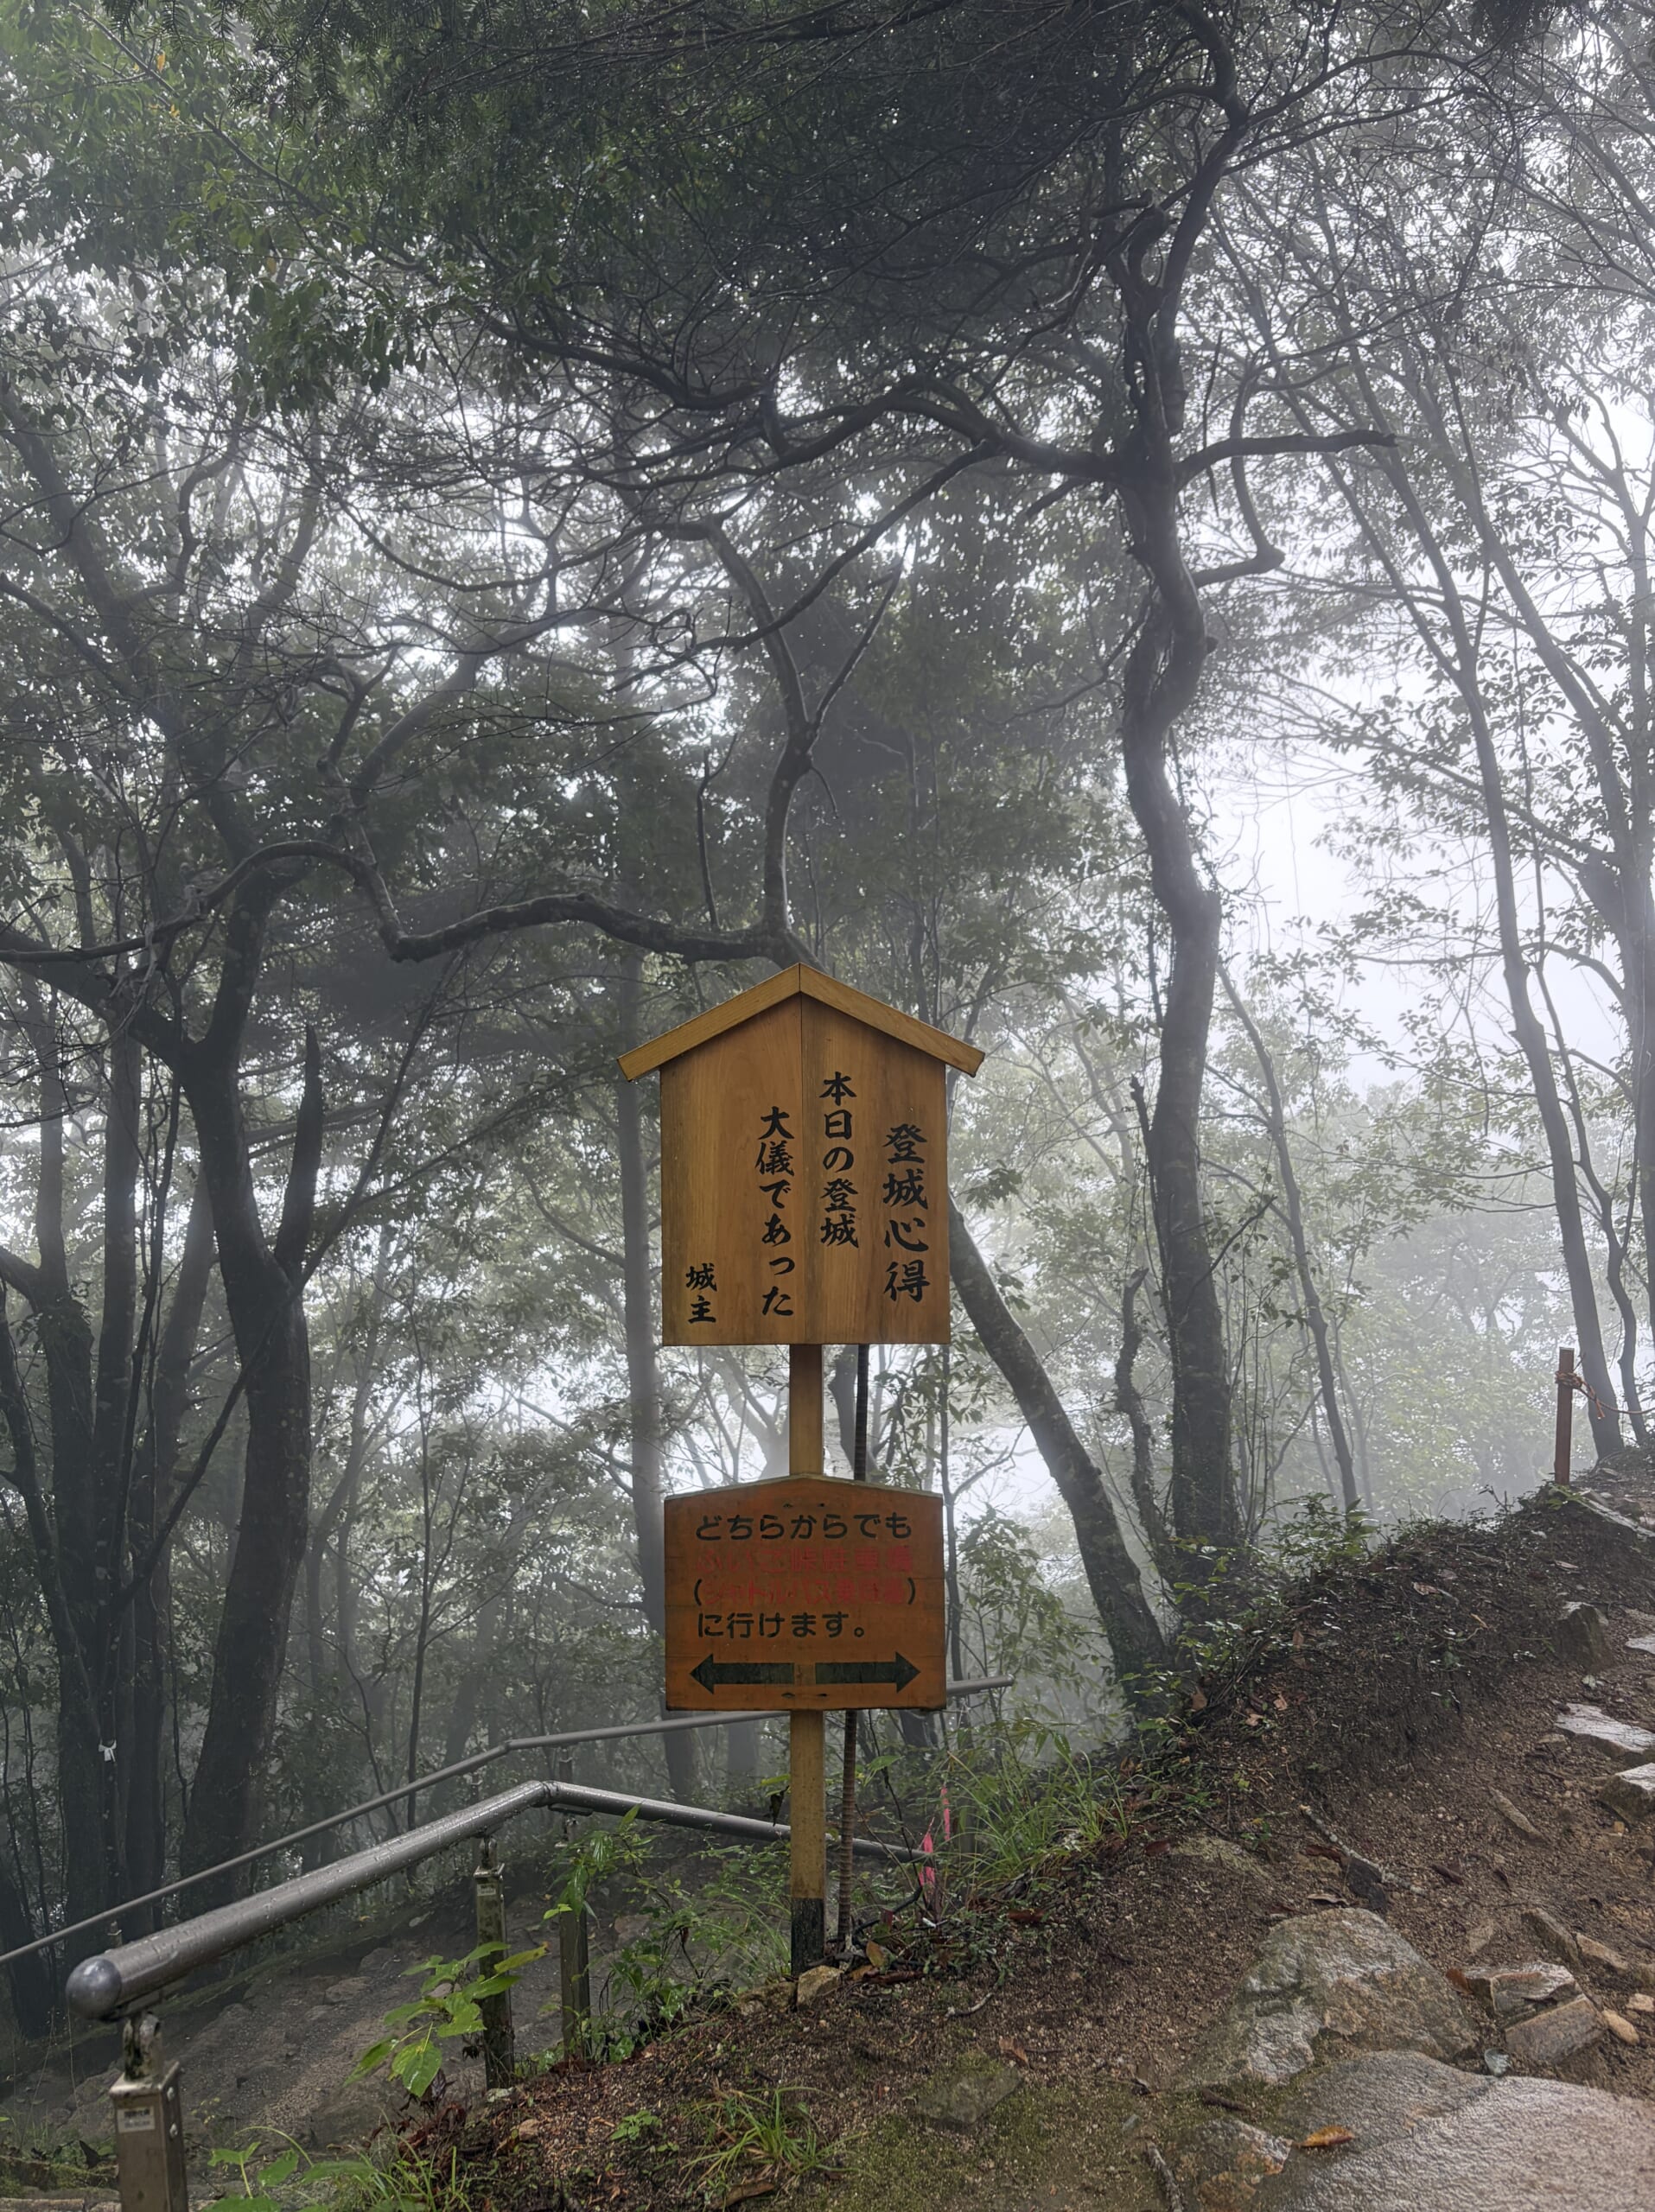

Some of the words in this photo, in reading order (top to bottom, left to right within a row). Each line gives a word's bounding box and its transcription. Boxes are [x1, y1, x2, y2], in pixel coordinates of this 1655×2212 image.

[754, 1106, 795, 1316] 大儀であった
[818, 1071, 859, 1249] 本日の登城
[882, 1124, 930, 1302] 登城心得
[685, 1262, 717, 1324] 城主
[696, 1512, 912, 1541] どちらからでも
[698, 1611, 865, 1638] に行けます。
